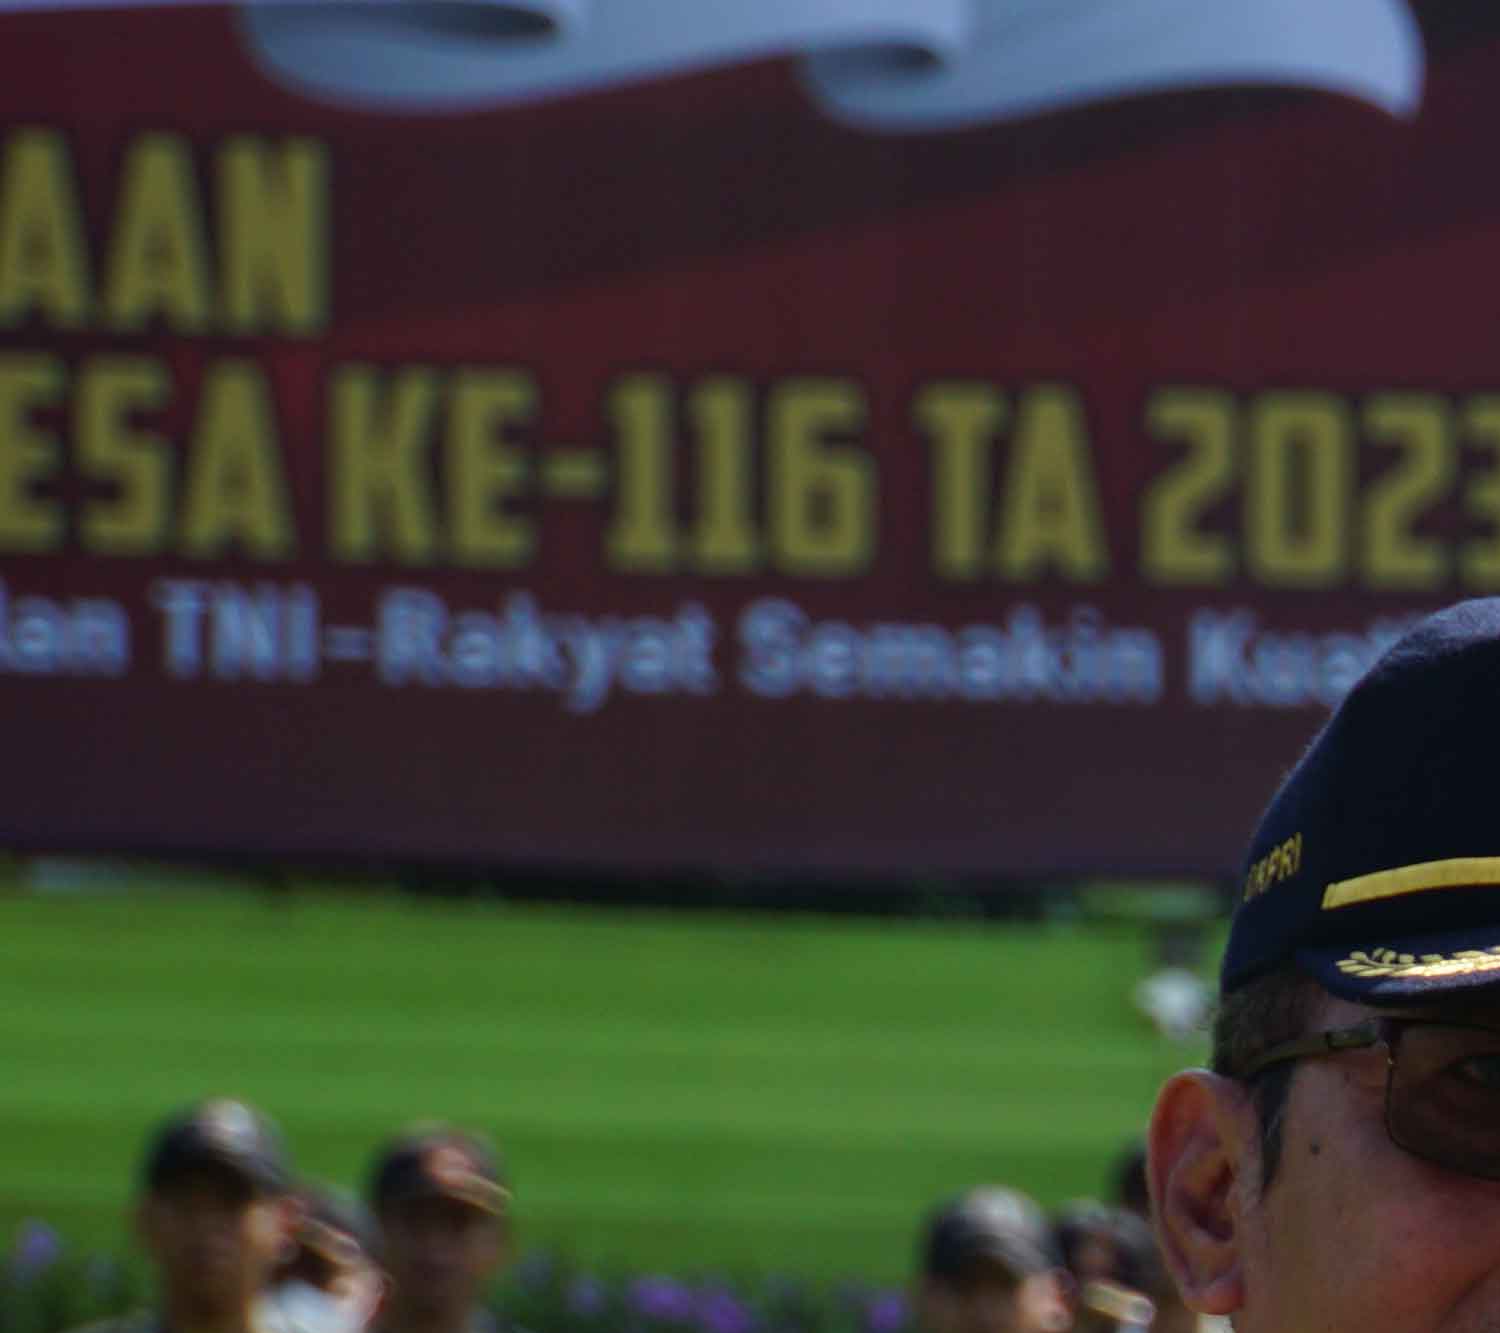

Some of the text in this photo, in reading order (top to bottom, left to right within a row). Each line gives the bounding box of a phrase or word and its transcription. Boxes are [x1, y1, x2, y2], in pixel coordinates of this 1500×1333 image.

[0, 130, 330, 336] AAN
[330, 362, 874, 577] KE-116
[914, 381, 1109, 580] TA
[153, 579, 713, 705] TNI-Rakyat
[739, 598, 1163, 701] Semakin
